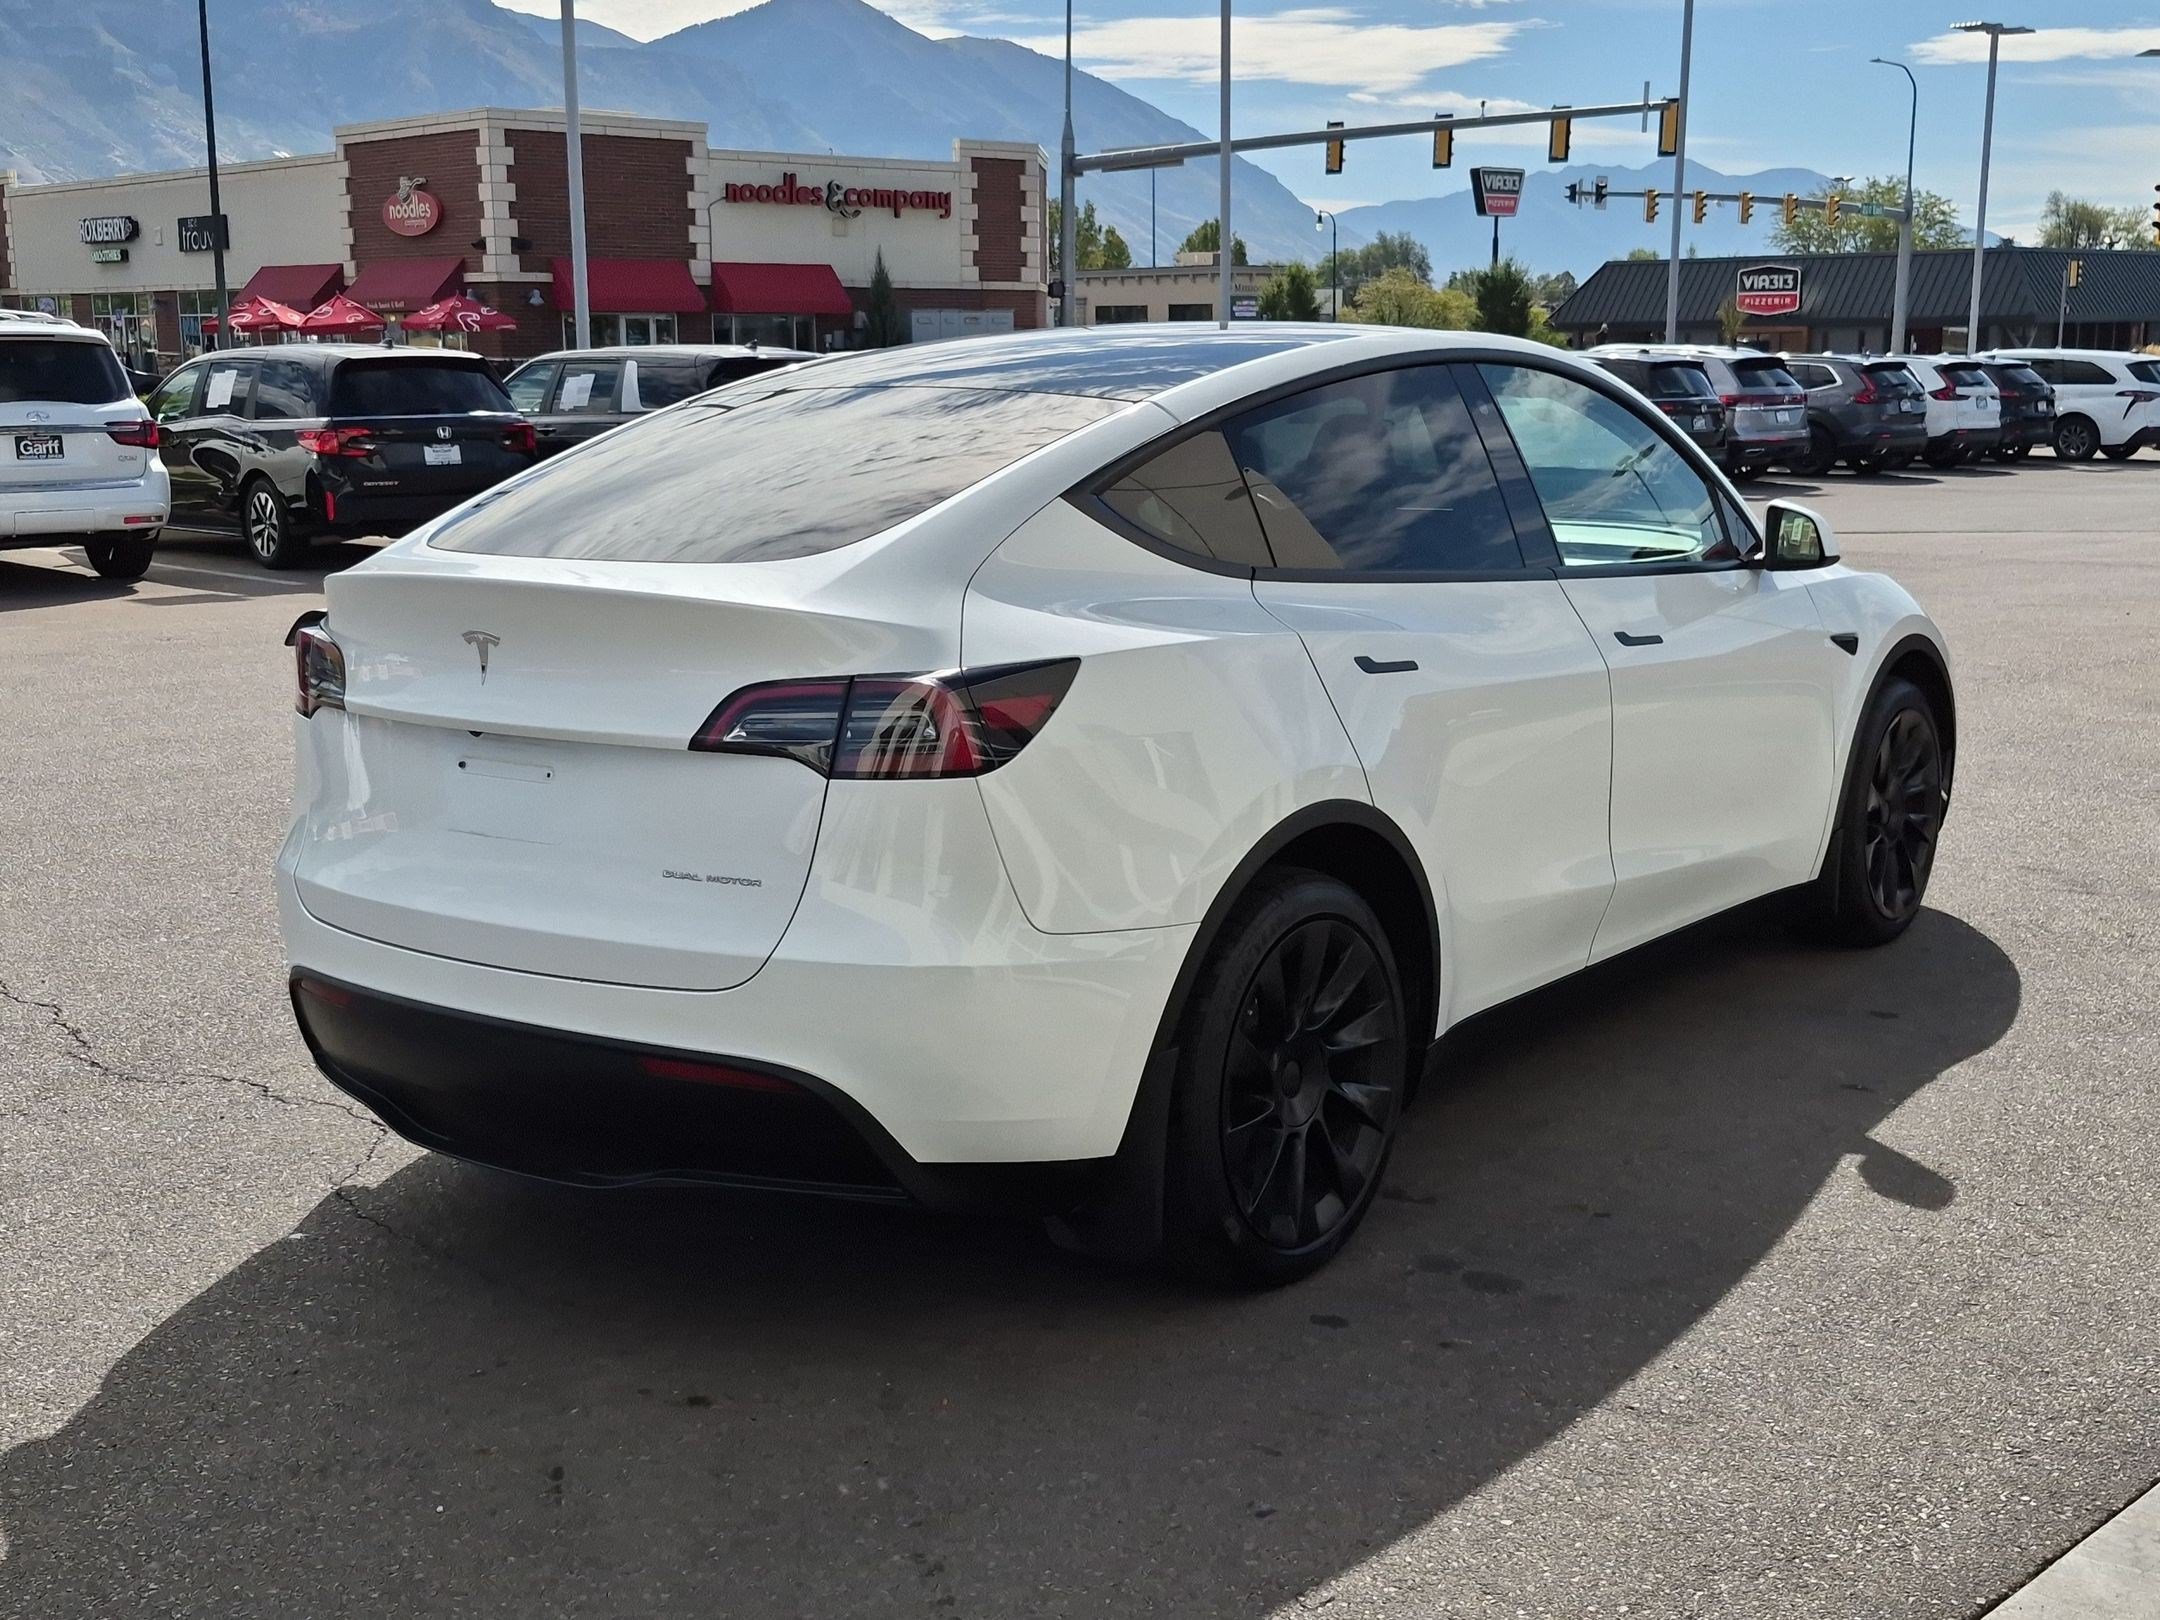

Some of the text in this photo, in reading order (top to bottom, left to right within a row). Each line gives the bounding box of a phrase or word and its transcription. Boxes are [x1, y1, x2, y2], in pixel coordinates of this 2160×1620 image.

[389, 194, 431, 219] noodles
[725, 172, 823, 206] noodles
[844, 187, 951, 219] company
[79, 217, 125, 242] ROXBERRY
[182, 226, 214, 251] trouv
[1744, 297, 1791, 306] PIZZERIA
[19, 439, 60, 455] Garff
[662, 869, 762, 888] DUAL MOTOR
